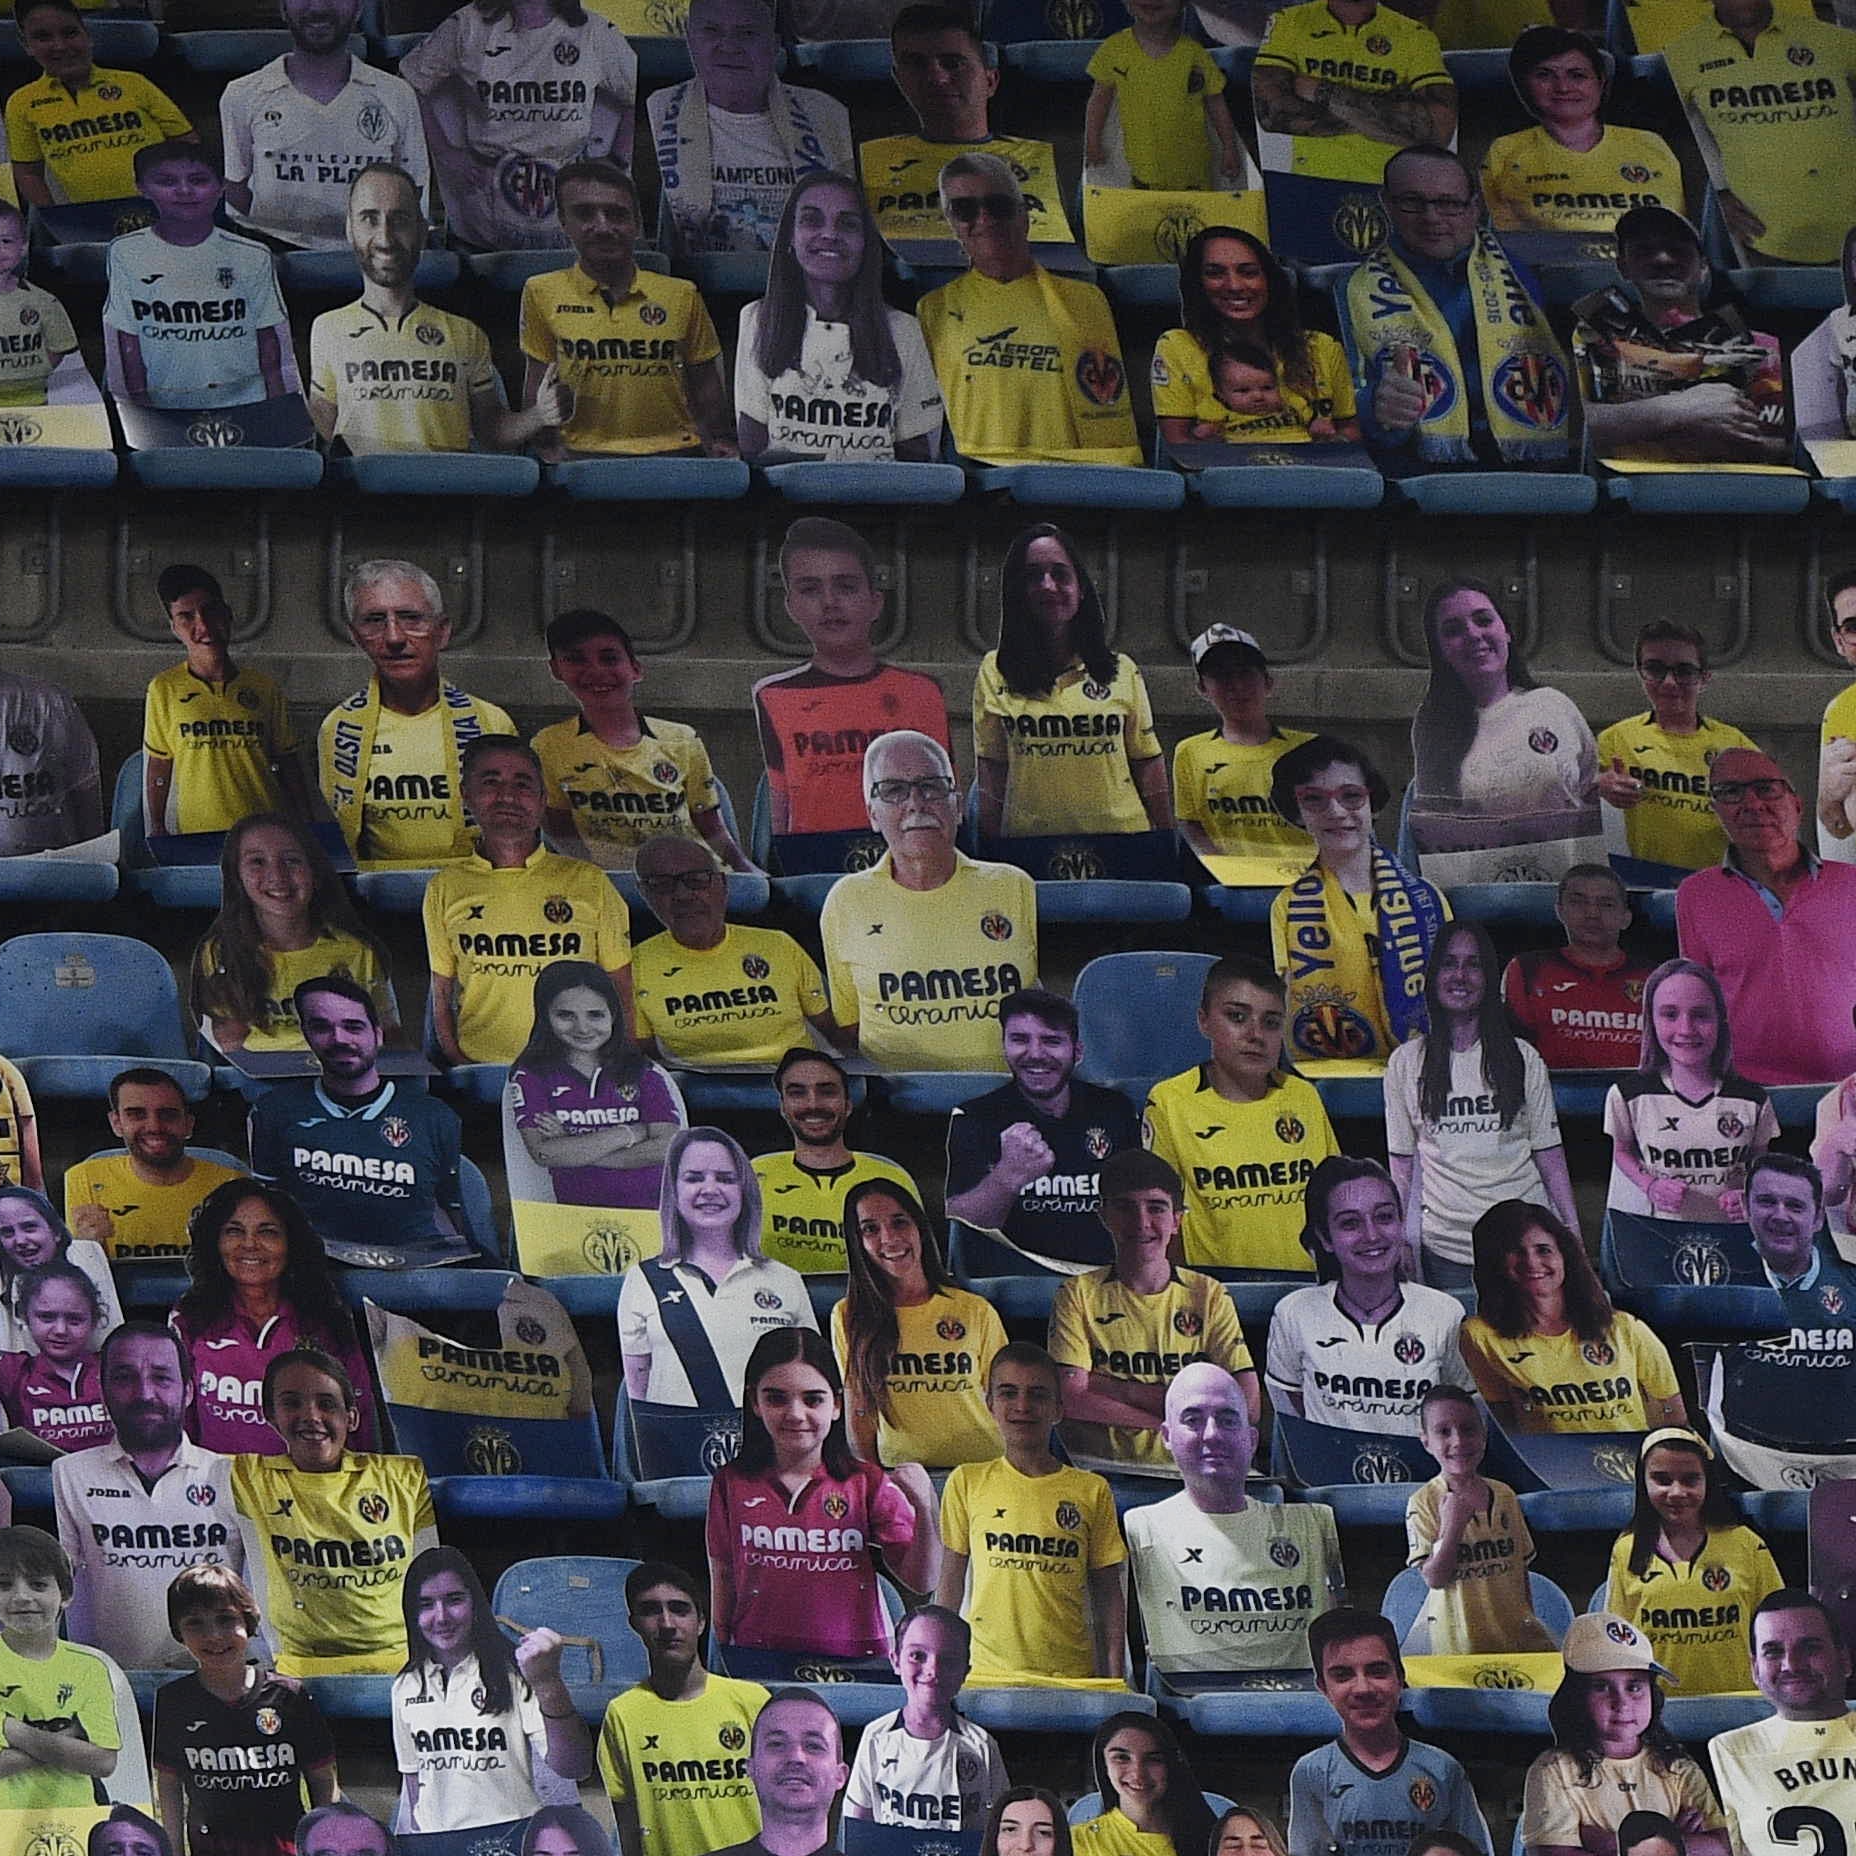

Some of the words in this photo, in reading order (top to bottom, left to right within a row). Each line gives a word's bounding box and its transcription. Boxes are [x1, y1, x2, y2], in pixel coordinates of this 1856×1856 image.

[1305, 57, 1398, 86] PAMESA
[478, 79, 587, 103] PAMESA
[1709, 77, 1836, 108] PAMESA
[132, 299, 246, 322] PAMESA
[559, 338, 676, 360] PAMESA
[346, 360, 458, 384] PAMESA
[771, 392, 893, 428] PAMESA
[1001, 713, 1120, 737] PAMESA
[568, 787, 686, 815] PAMESA
[457, 932, 581, 957] PAMESA
[878, 963, 1022, 1002] PAMESA
[663, 985, 779, 1016] PAMESA
[554, 1104, 640, 1126] PAMESA
[294, 1146, 415, 1184] PAMESA
[1194, 1158, 1315, 1190] PAMESA
[416, 1335, 561, 1378] PAMESA
[1313, 1372, 1450, 1399] PAMESA
[92, 1523, 228, 1548] PAMESA
[271, 1535, 406, 1562] PAMESA
[741, 1523, 864, 1554] PAMESA
[984, 1532, 1080, 1558] PAMESA
[1181, 1585, 1314, 1612] PAMESA
[1641, 1605, 1740, 1628] PAMESA
[186, 1745, 295, 1770] PAMESA
